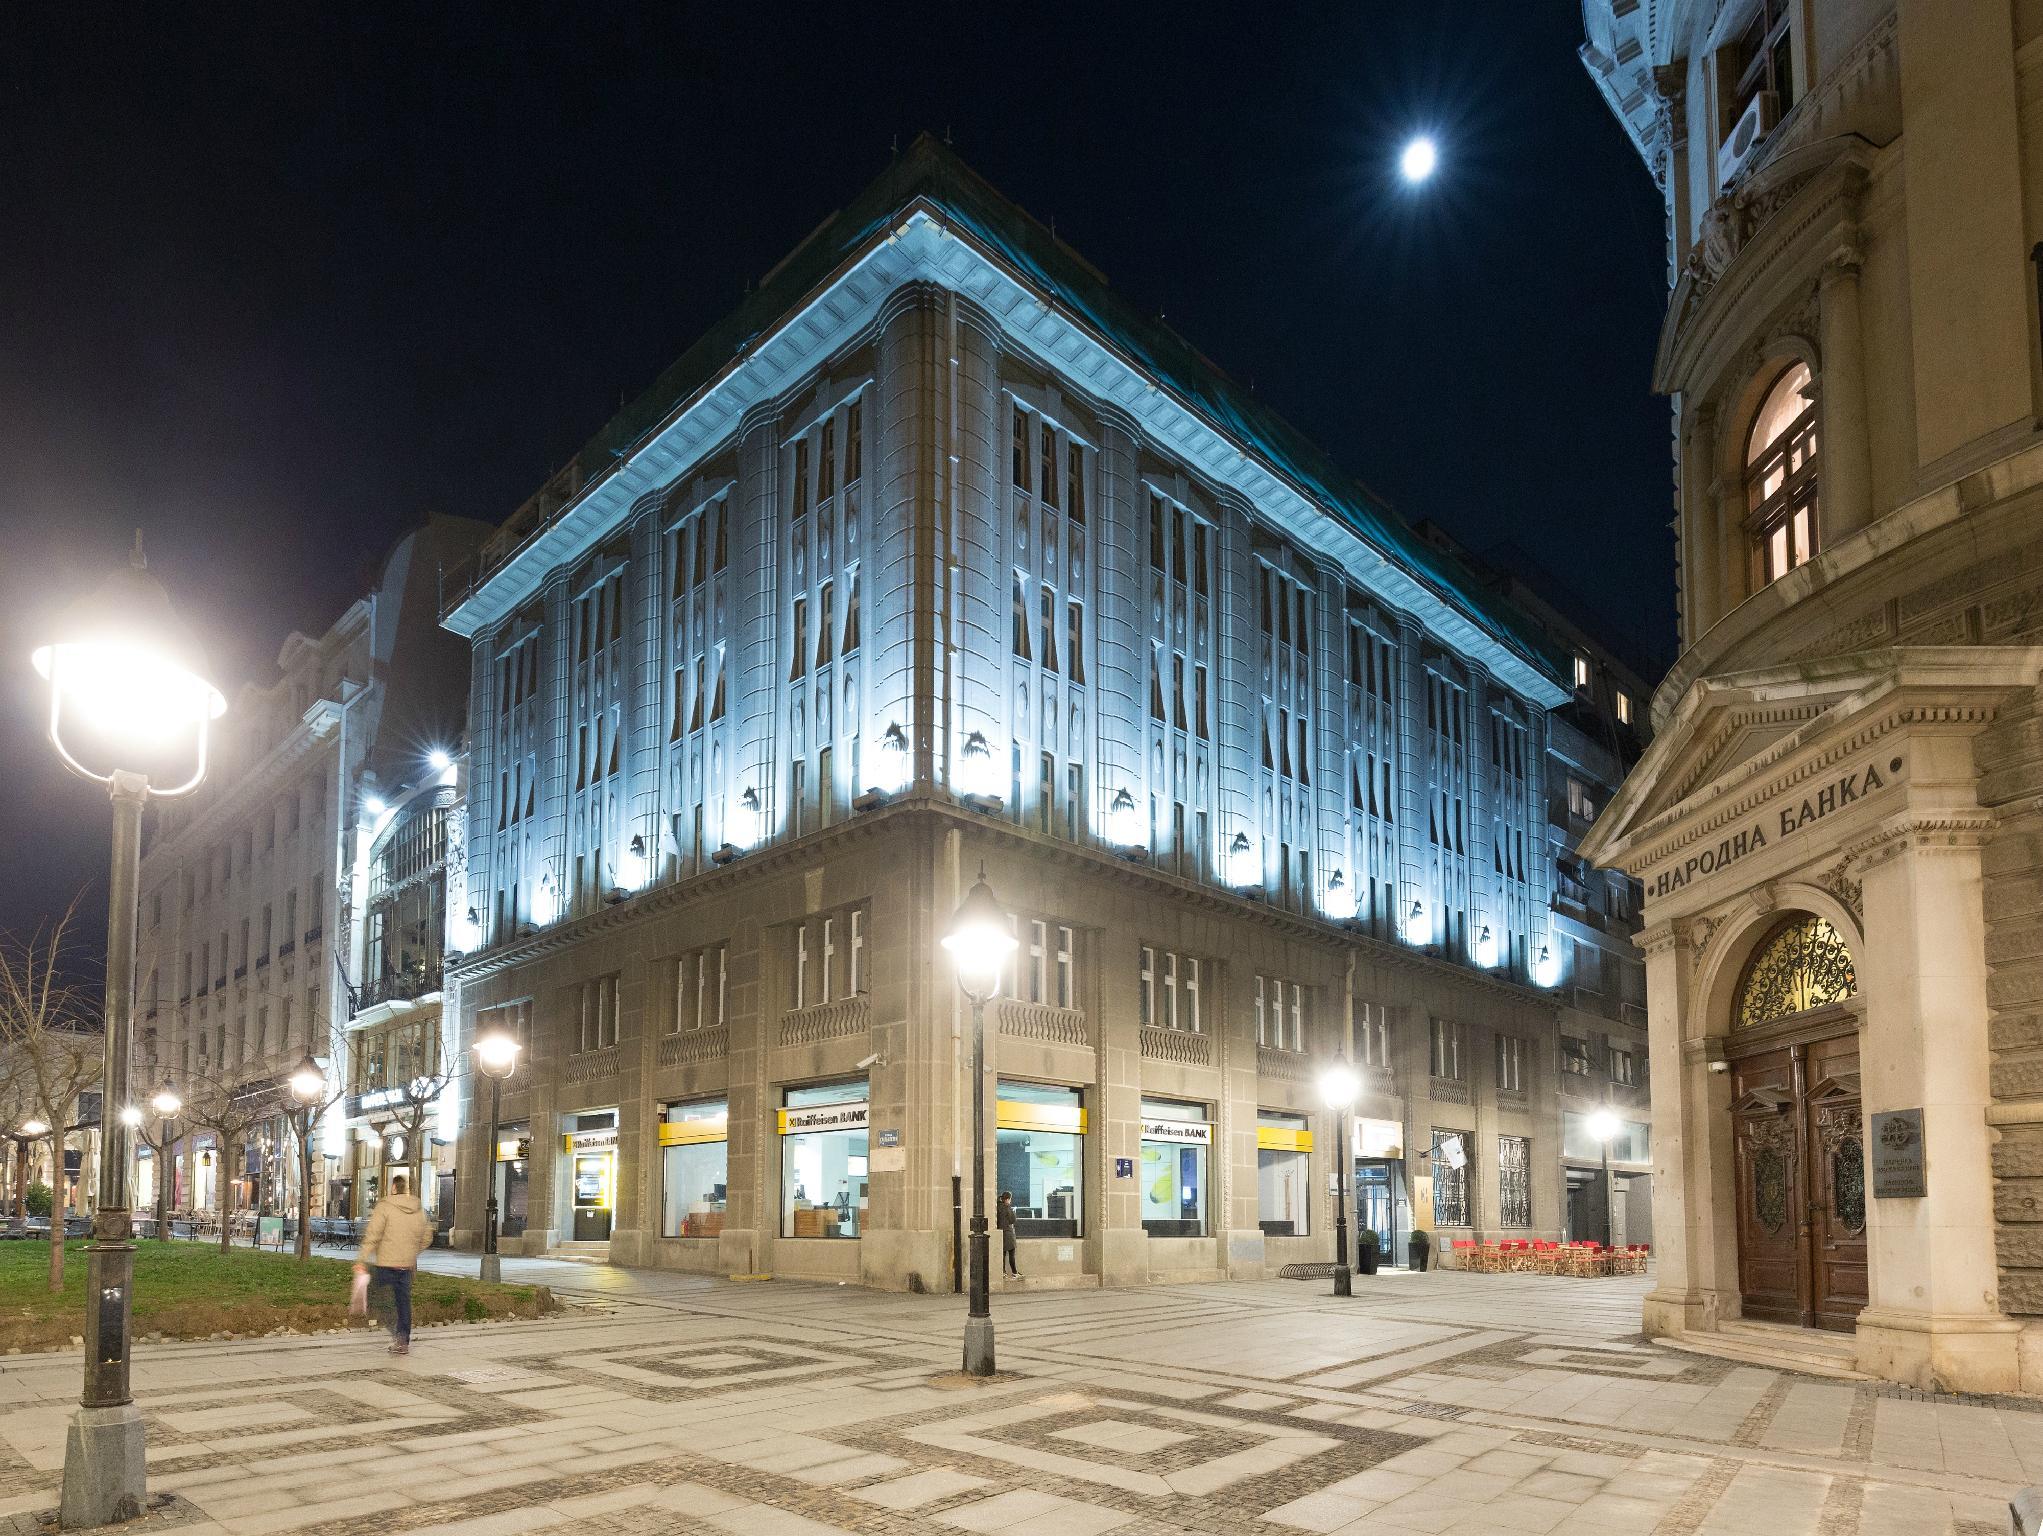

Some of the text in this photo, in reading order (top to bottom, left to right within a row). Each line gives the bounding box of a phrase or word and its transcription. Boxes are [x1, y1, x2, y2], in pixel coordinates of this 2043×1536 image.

[1657, 764, 1884, 897] НАРОДНА БАНКА
[796, 1109, 867, 1127] Raiffeisen BANK
[1144, 1124, 1207, 1139] Raiffeisen BANK
